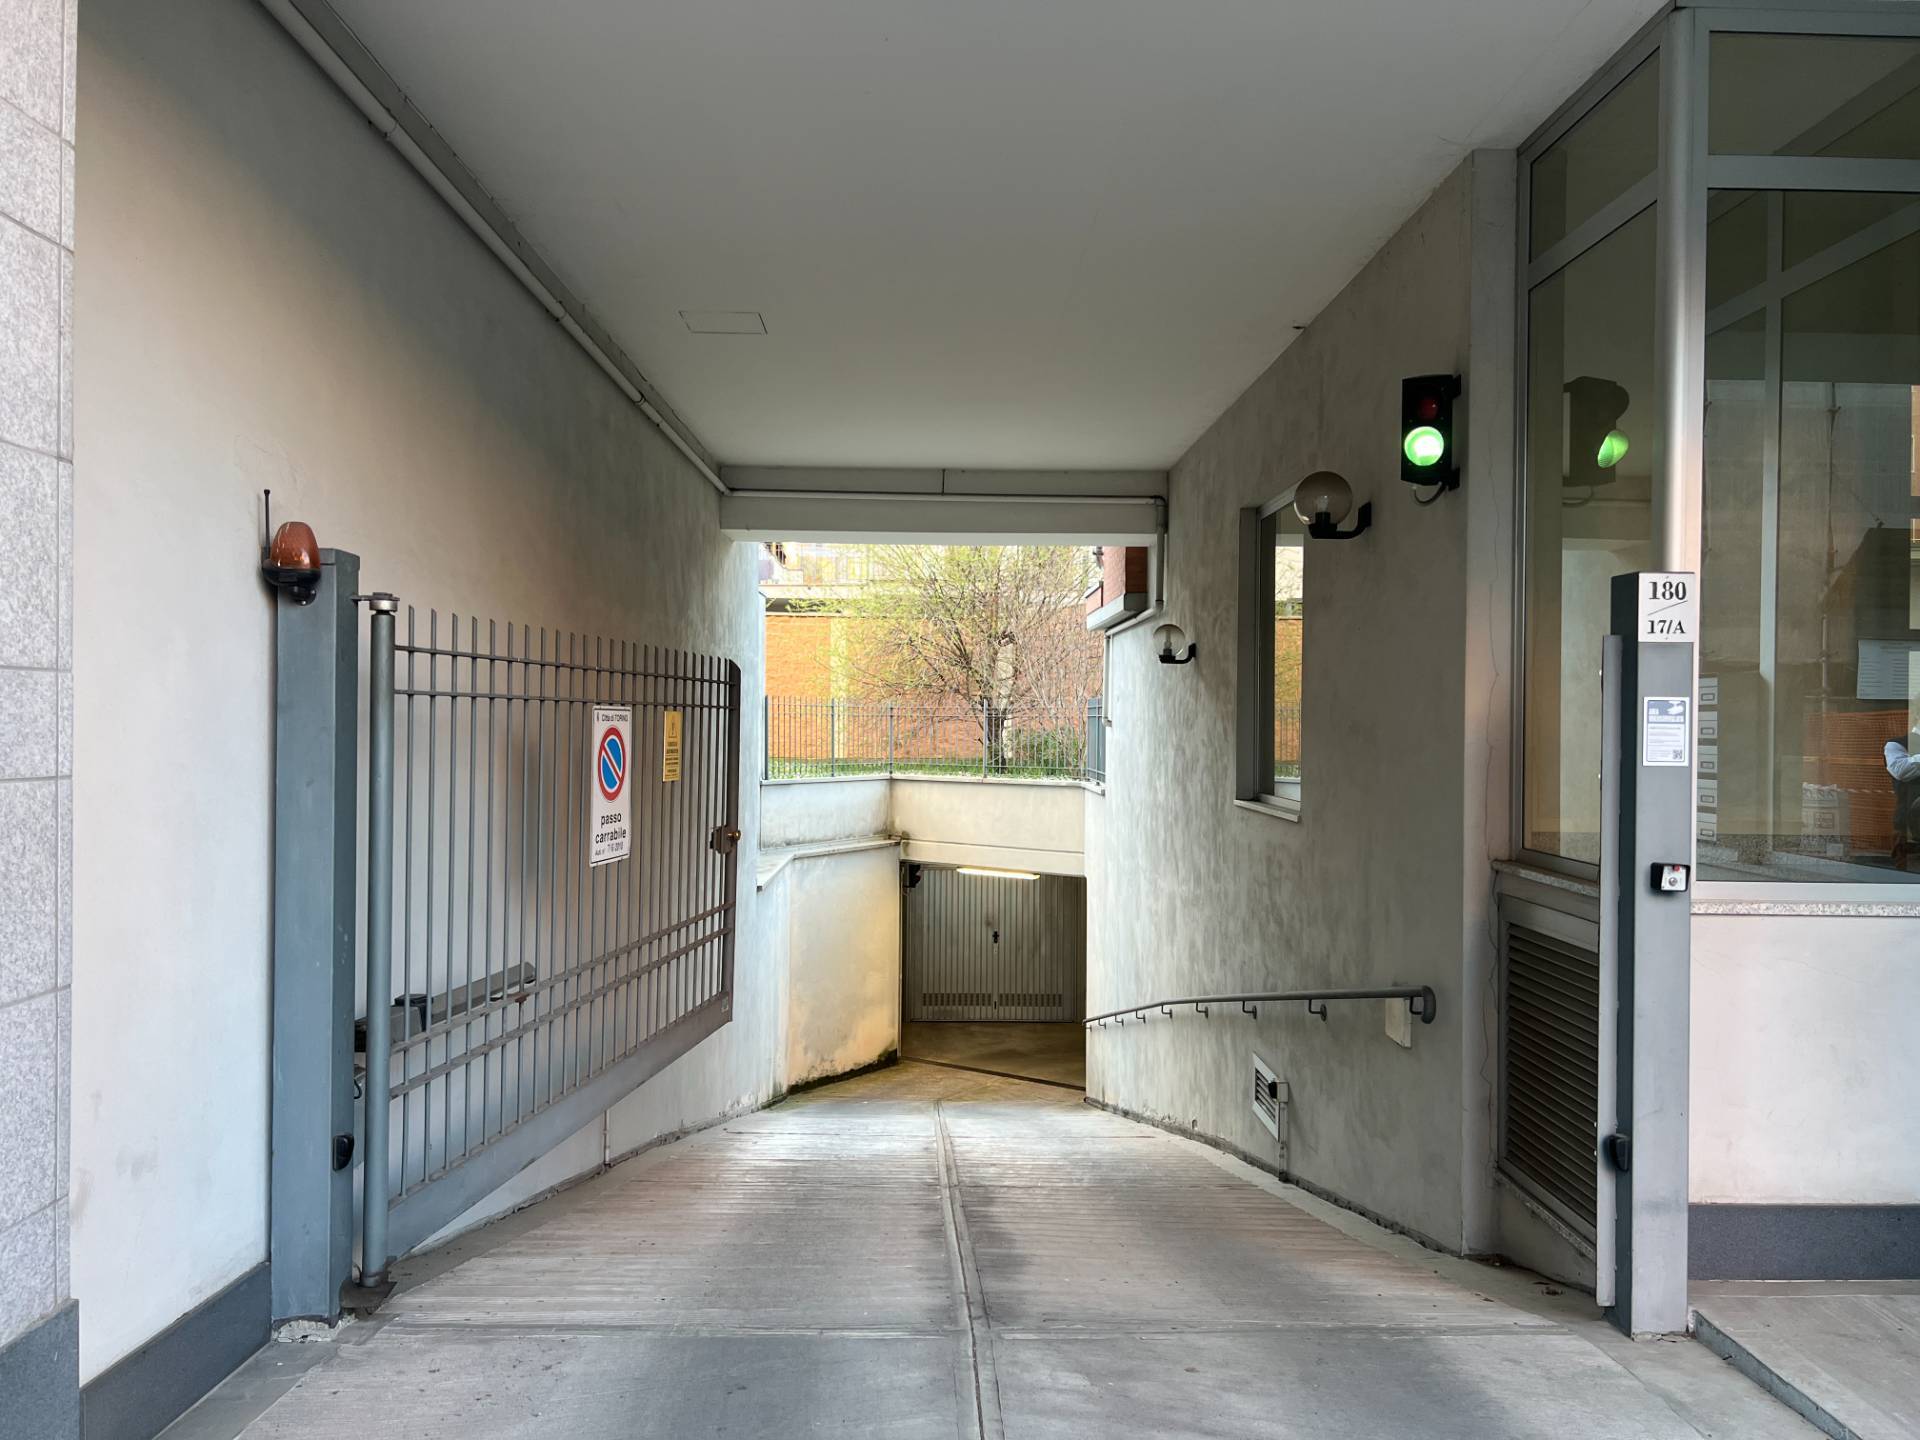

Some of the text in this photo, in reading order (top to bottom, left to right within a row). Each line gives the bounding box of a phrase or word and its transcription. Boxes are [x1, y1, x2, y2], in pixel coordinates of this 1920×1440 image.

[1648, 581, 1687, 601] 180
[1647, 619, 1686, 635] 17/A
[601, 812, 622, 829] passo
[595, 827, 627, 845] carrabile
